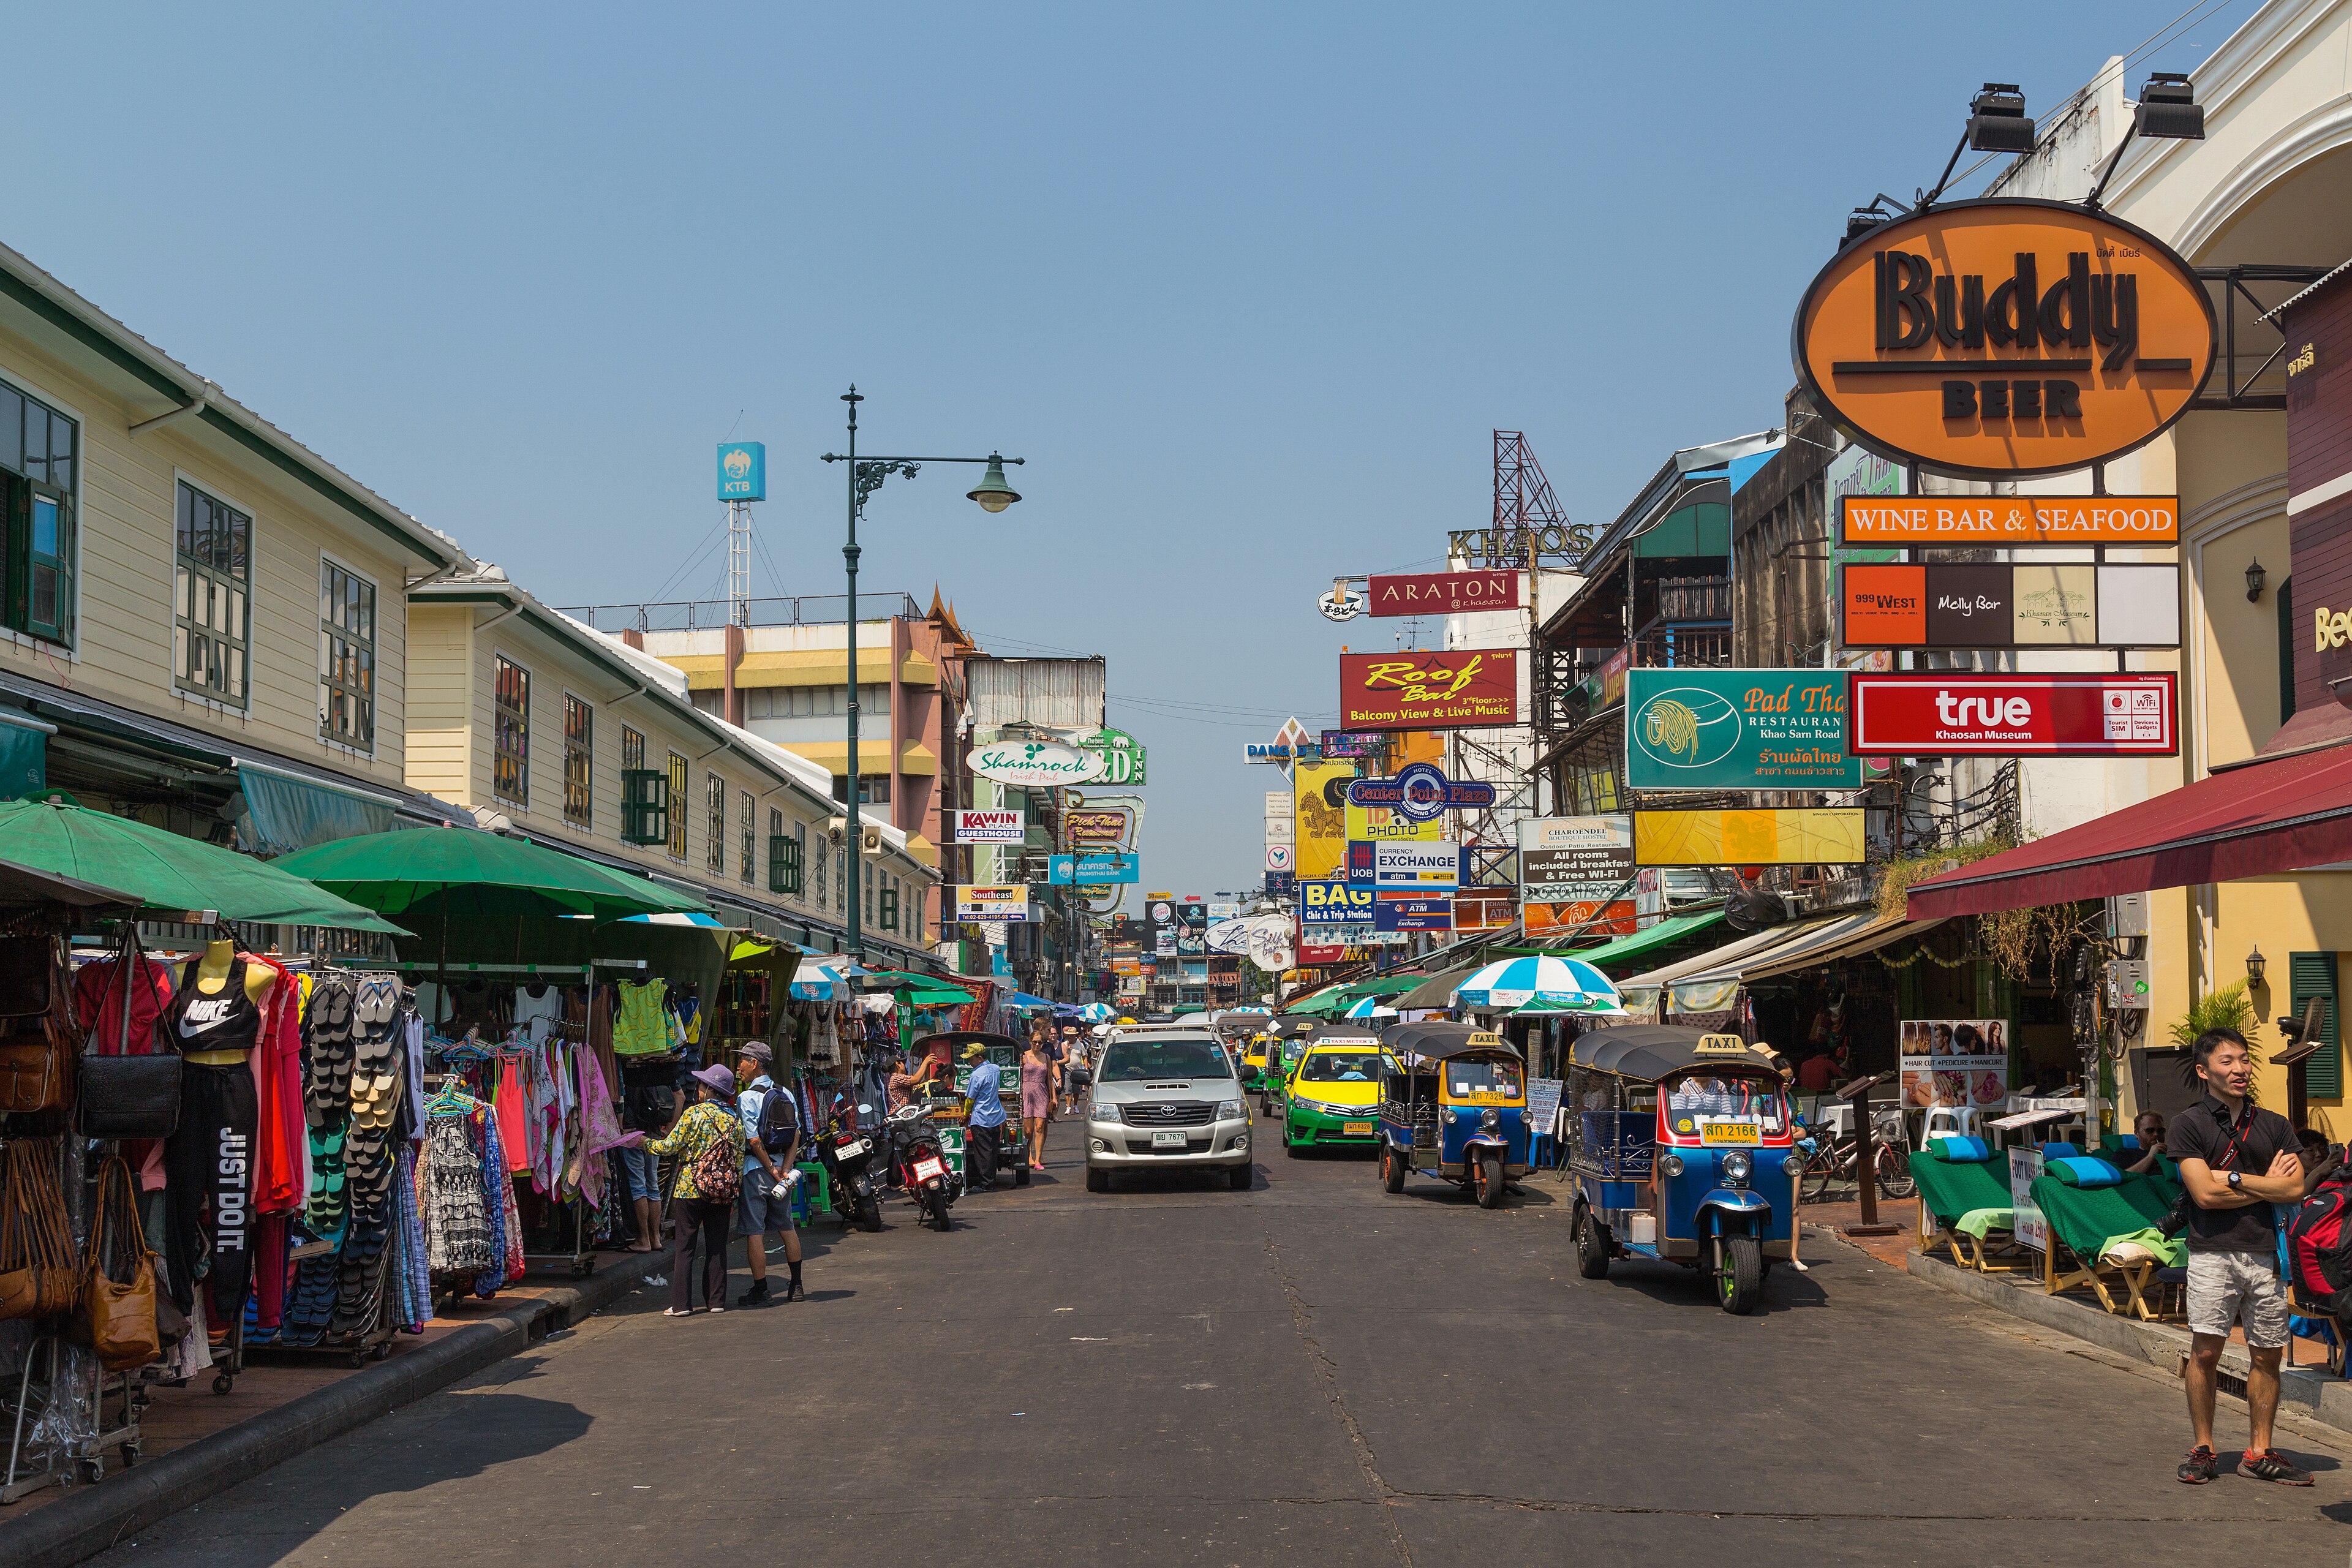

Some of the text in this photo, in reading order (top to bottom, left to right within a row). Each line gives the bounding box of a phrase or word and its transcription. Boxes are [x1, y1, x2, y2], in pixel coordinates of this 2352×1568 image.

[2119, 247, 2140, 257] เบียร์
[1874, 251, 2138, 371] Buddy
[1941, 380, 2082, 418] BEER
[725, 481, 750, 492] KTB
[1850, 508, 2173, 531] WINE BAR & SEAFOOD
[1447, 524, 1611, 559] KHAOS
[1382, 579, 1506, 601] ARATON
[1855, 594, 1875, 603] 999
[1938, 595, 2001, 617] Molly Bar
[1365, 654, 1483, 692] Roof
[1401, 685, 1457, 702] Bar
[1744, 684, 1844, 712] Pad Tha
[1351, 704, 1510, 722] Balcony View & Live Music
[1936, 690, 2032, 726] true
[1749, 717, 1841, 726] RESTAURAN
[1760, 729, 1840, 739] Khao Sarn Road
[1936, 730, 2032, 740] Khaosan Museum
[1247, 745, 1290, 756] DANG
[1759, 747, 1841, 763] ร้านผัดไทย
[980, 752, 1088, 772] Shamrock
[1090, 750, 1131, 783] &D
[1134, 750, 1144, 781] INN
[1010, 771, 1058, 782] Irish Pub
[1755, 765, 1845, 775] สาขา ถนนข้าวสาร
[1355, 785, 1490, 802] Center Point Plaza
[1401, 801, 1444, 816] SHOPPING MALL
[963, 813, 1017, 828] KAWIN
[1367, 824, 1419, 836] PHOTO
[1379, 856, 1455, 867] EXCHANGE
[1529, 862, 1577, 870] included
[1351, 869, 1374, 877] UOB
[1588, 870, 1619, 878] WI-FI
[971, 891, 1013, 899] Southeast
[1306, 884, 1372, 905] BAG
[1306, 910, 1372, 921] Chic & Trip Station
[1490, 908, 1512, 918] ATM
[185, 999, 232, 1022] NIKE
[1705, 1038, 1737, 1049] TAXI
[1727, 1125, 1756, 1137] 2166
[2011, 1159, 2024, 1180] FOOT
[216, 1127, 247, 1253] JUST DO IT.
[2020, 1194, 2032, 1208] HOUR
[2022, 1219, 2043, 1240] HOUR 250
